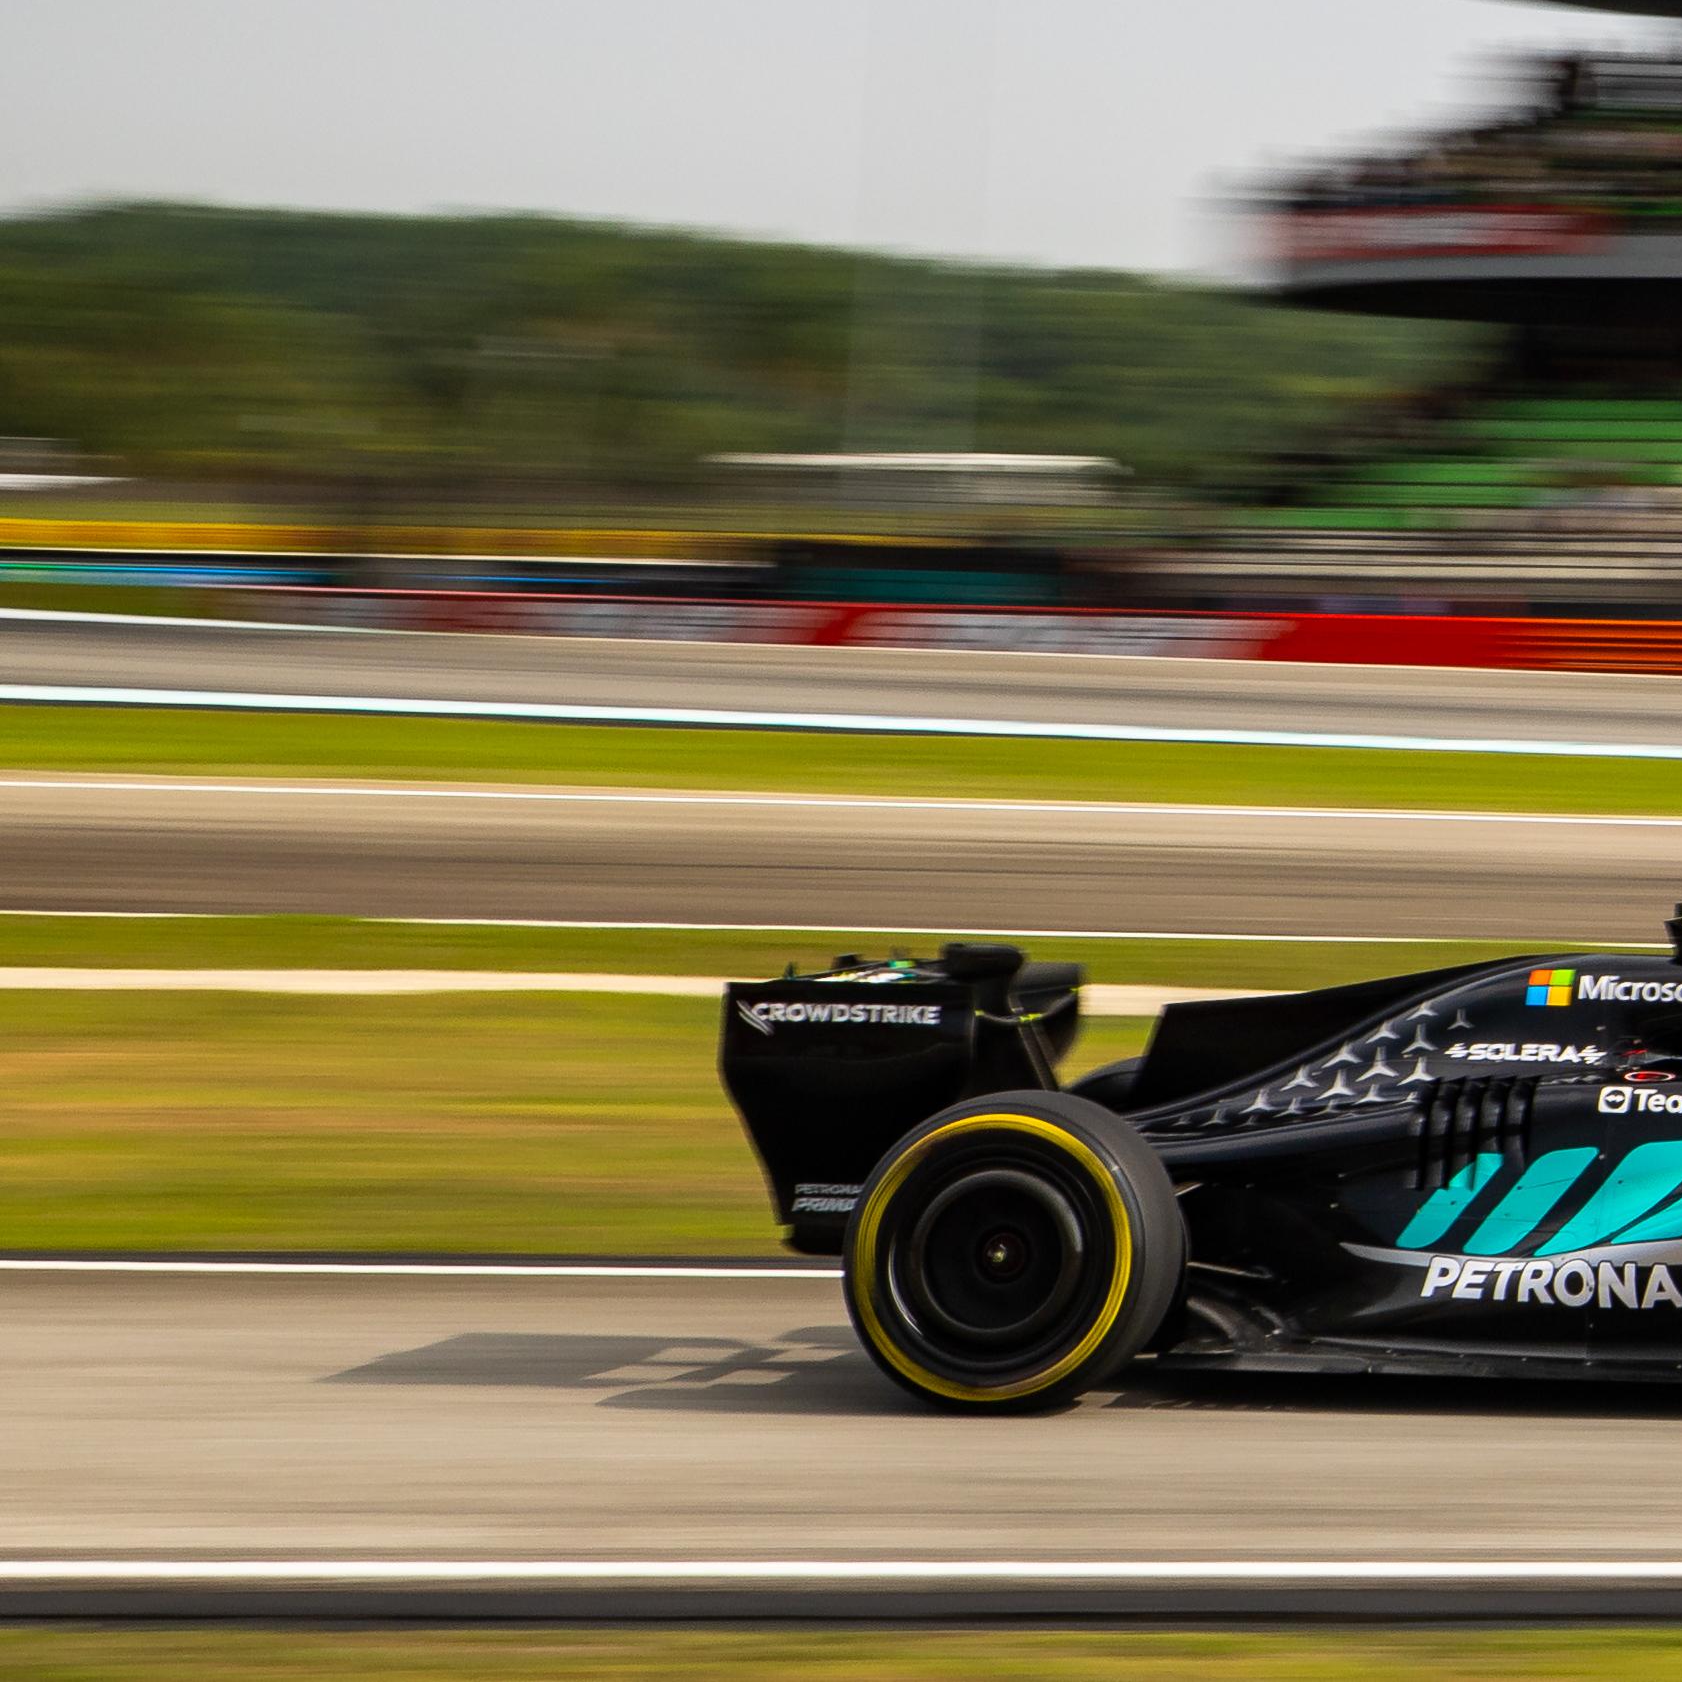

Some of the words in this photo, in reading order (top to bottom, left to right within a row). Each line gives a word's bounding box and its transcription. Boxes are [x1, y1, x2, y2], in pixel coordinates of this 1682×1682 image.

[752, 1002, 941, 1024] CROWDSTRIKE
[1467, 1043, 1582, 1063] SOLERA
[794, 1183, 864, 1195] PETRONA
